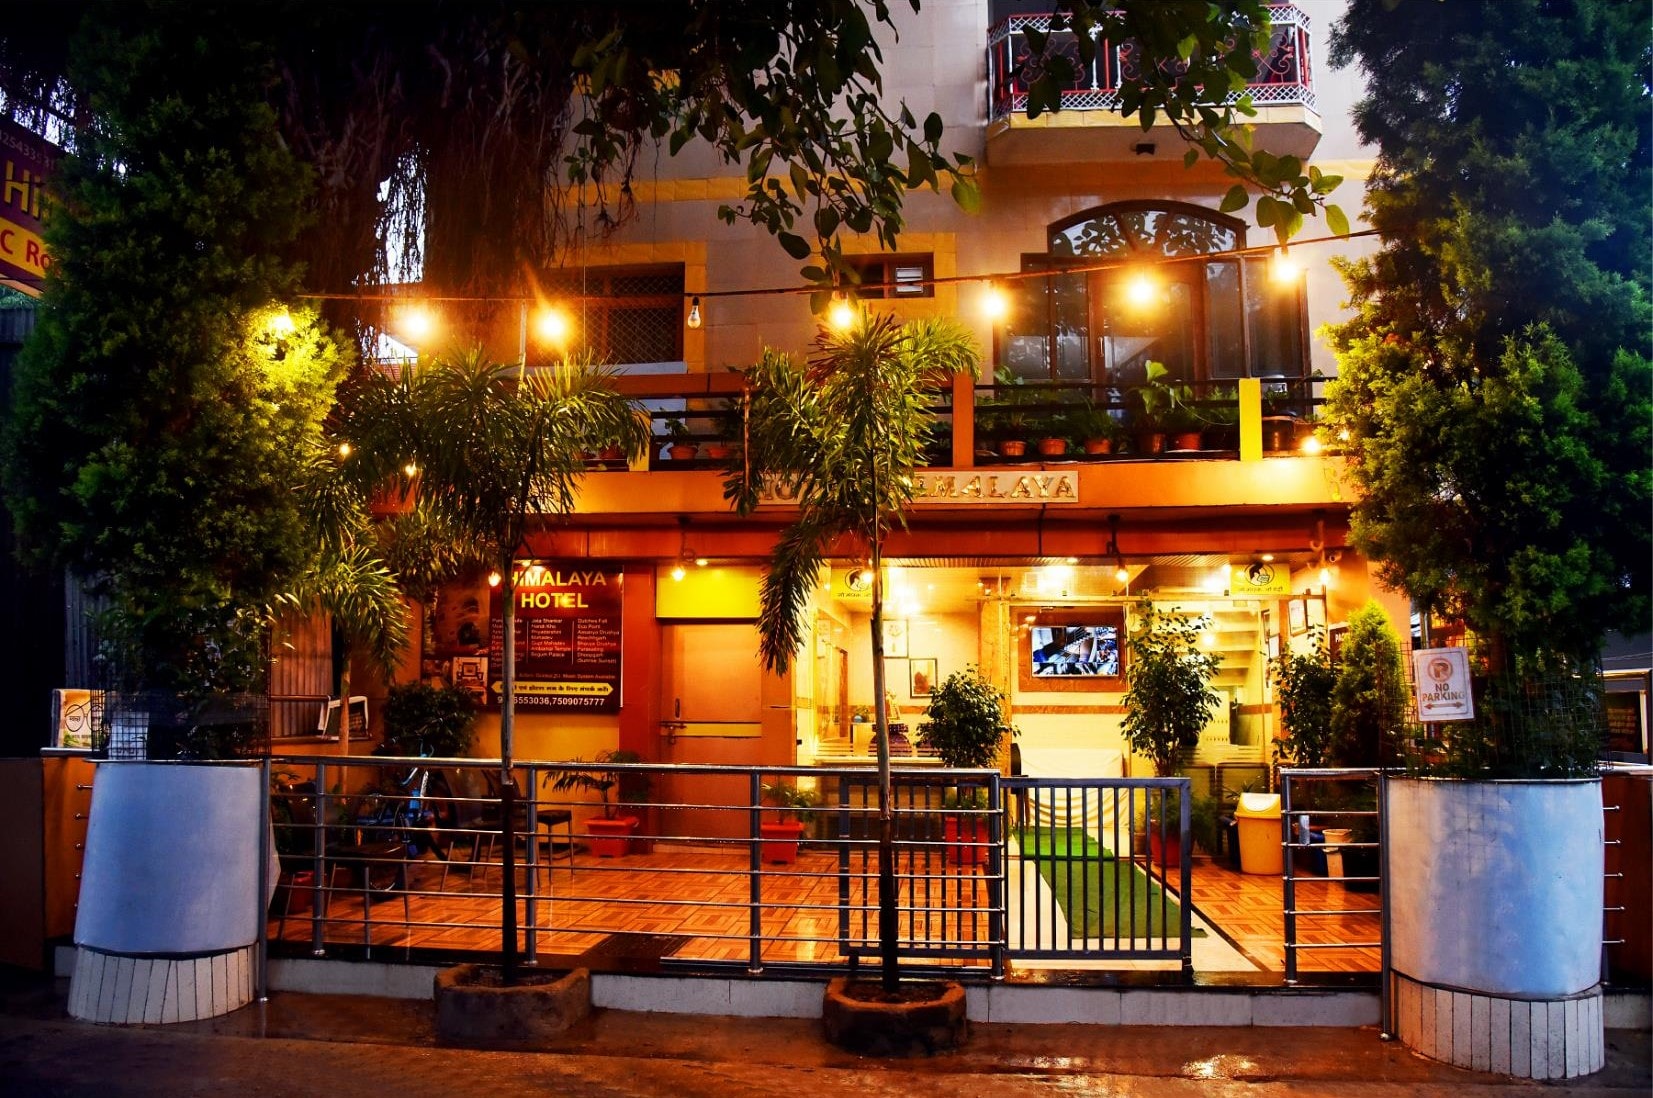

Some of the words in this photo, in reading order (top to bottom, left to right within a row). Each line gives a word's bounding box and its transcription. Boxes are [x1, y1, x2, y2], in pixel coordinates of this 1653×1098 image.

[912, 476, 1077, 498] IMALAYA
[521, 592, 589, 609] HOTEL
[1434, 683, 1450, 692] NO
[1422, 692, 1465, 701] PARKING
